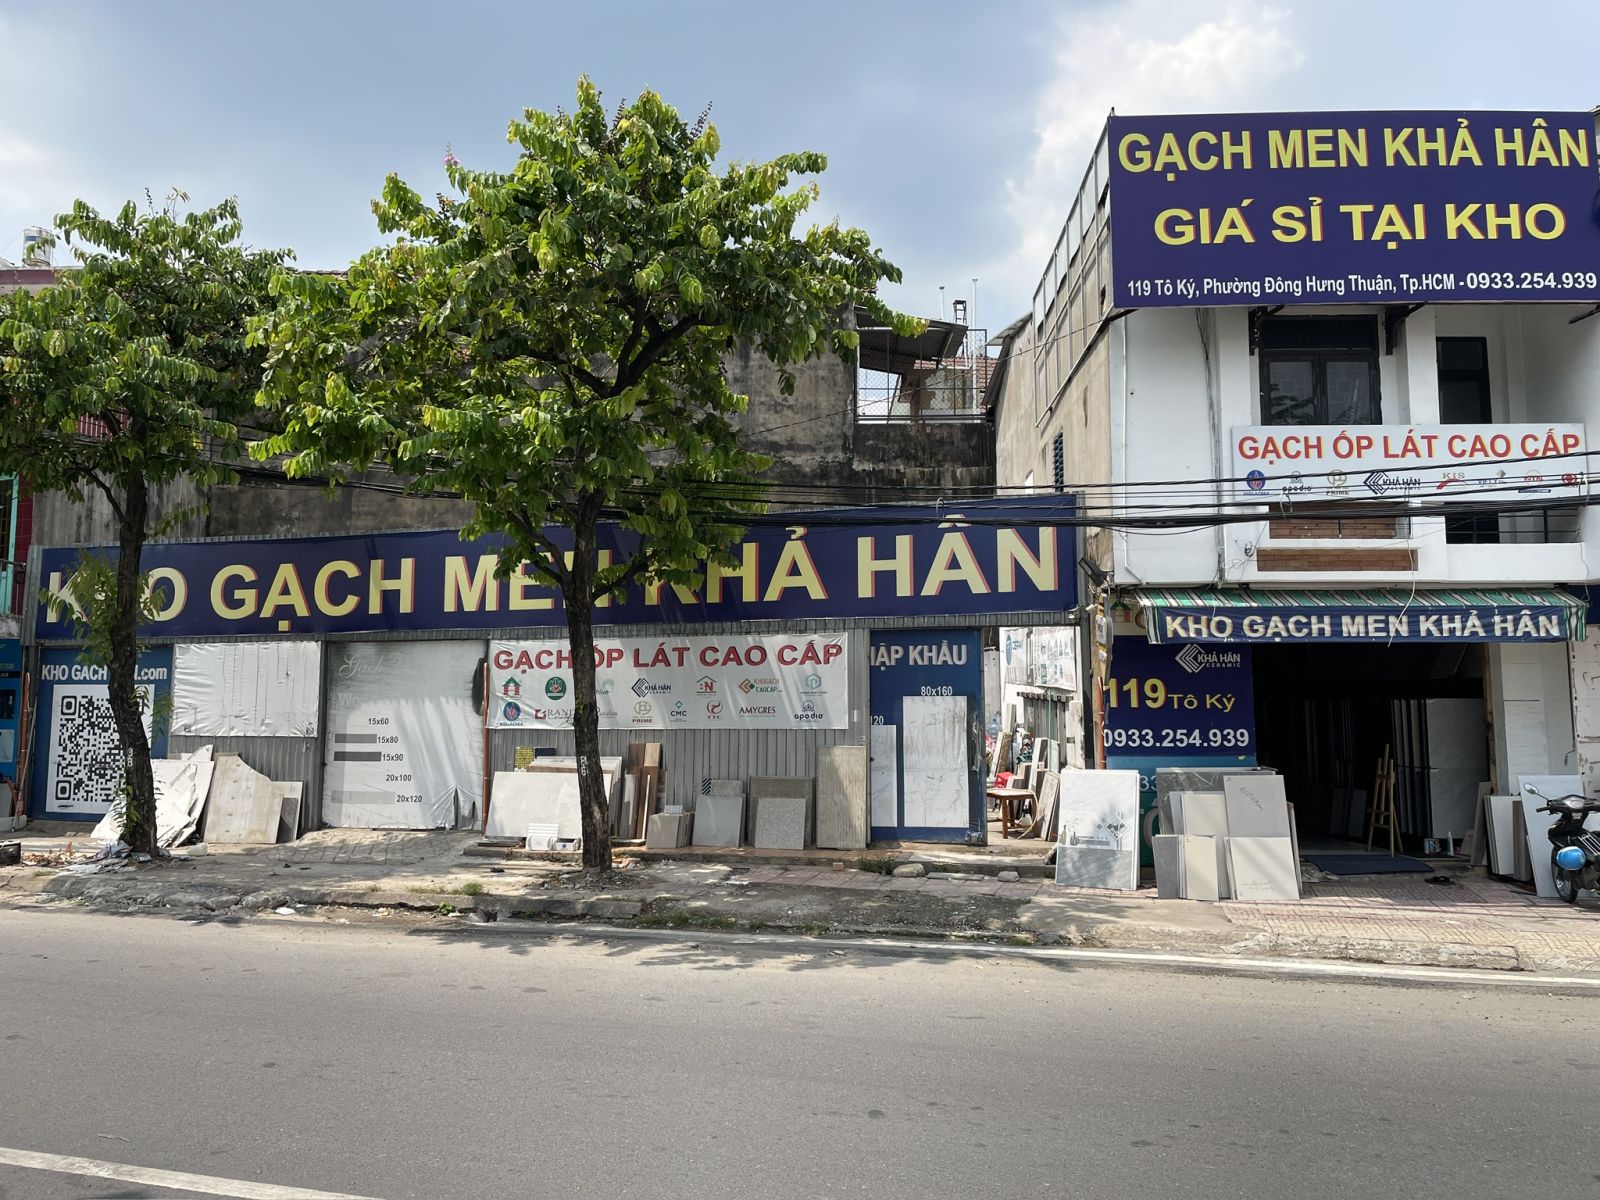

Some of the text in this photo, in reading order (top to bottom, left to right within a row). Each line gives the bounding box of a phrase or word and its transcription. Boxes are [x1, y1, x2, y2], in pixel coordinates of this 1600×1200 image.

[1118, 118, 1590, 181] GẠCH MEN KHẢ HÂN
[1154, 196, 1566, 249] GIÁ SỈ TẠI KHO
[1128, 280, 1150, 296] 119
[1155, 279, 1172, 295] Tô
[1177, 278, 1199, 298] Ký,
[1203, 278, 1260, 297] Phường
[1264, 276, 1302, 297] Đông
[1306, 275, 1345, 296] Hưng
[1348, 274, 1396, 295] Thuận,
[1400, 273, 1455, 294] Tp.HCM
[1238, 428, 1580, 465] GẠCH ỐP LÁT CAO CẤP
[46, 567, 188, 623] KO
[210, 557, 415, 632] GẠCH
[857, 513, 1059, 598] HÂN
[1166, 609, 1560, 641] KHO GẠCH MEN KHẢ HÂN
[494, 649, 573, 674] GẠCH
[633, 642, 690, 667] LÁT
[699, 645, 767, 667] CAO
[777, 639, 843, 666] CẤP
[909, 639, 967, 666] KHẨU
[1220, 652, 1241, 662] HÂN
[41, 665, 68, 680] KHO
[71, 665, 107, 680] GACH
[921, 686, 953, 696] 80x160
[1103, 678, 1235, 712] 119 Tô Ký
[739, 706, 775, 714] AMYGRES
[1104, 728, 1249, 747] 0933.254.939
[386, 774, 412, 782] 20x100
[397, 795, 423, 803] 20x120
